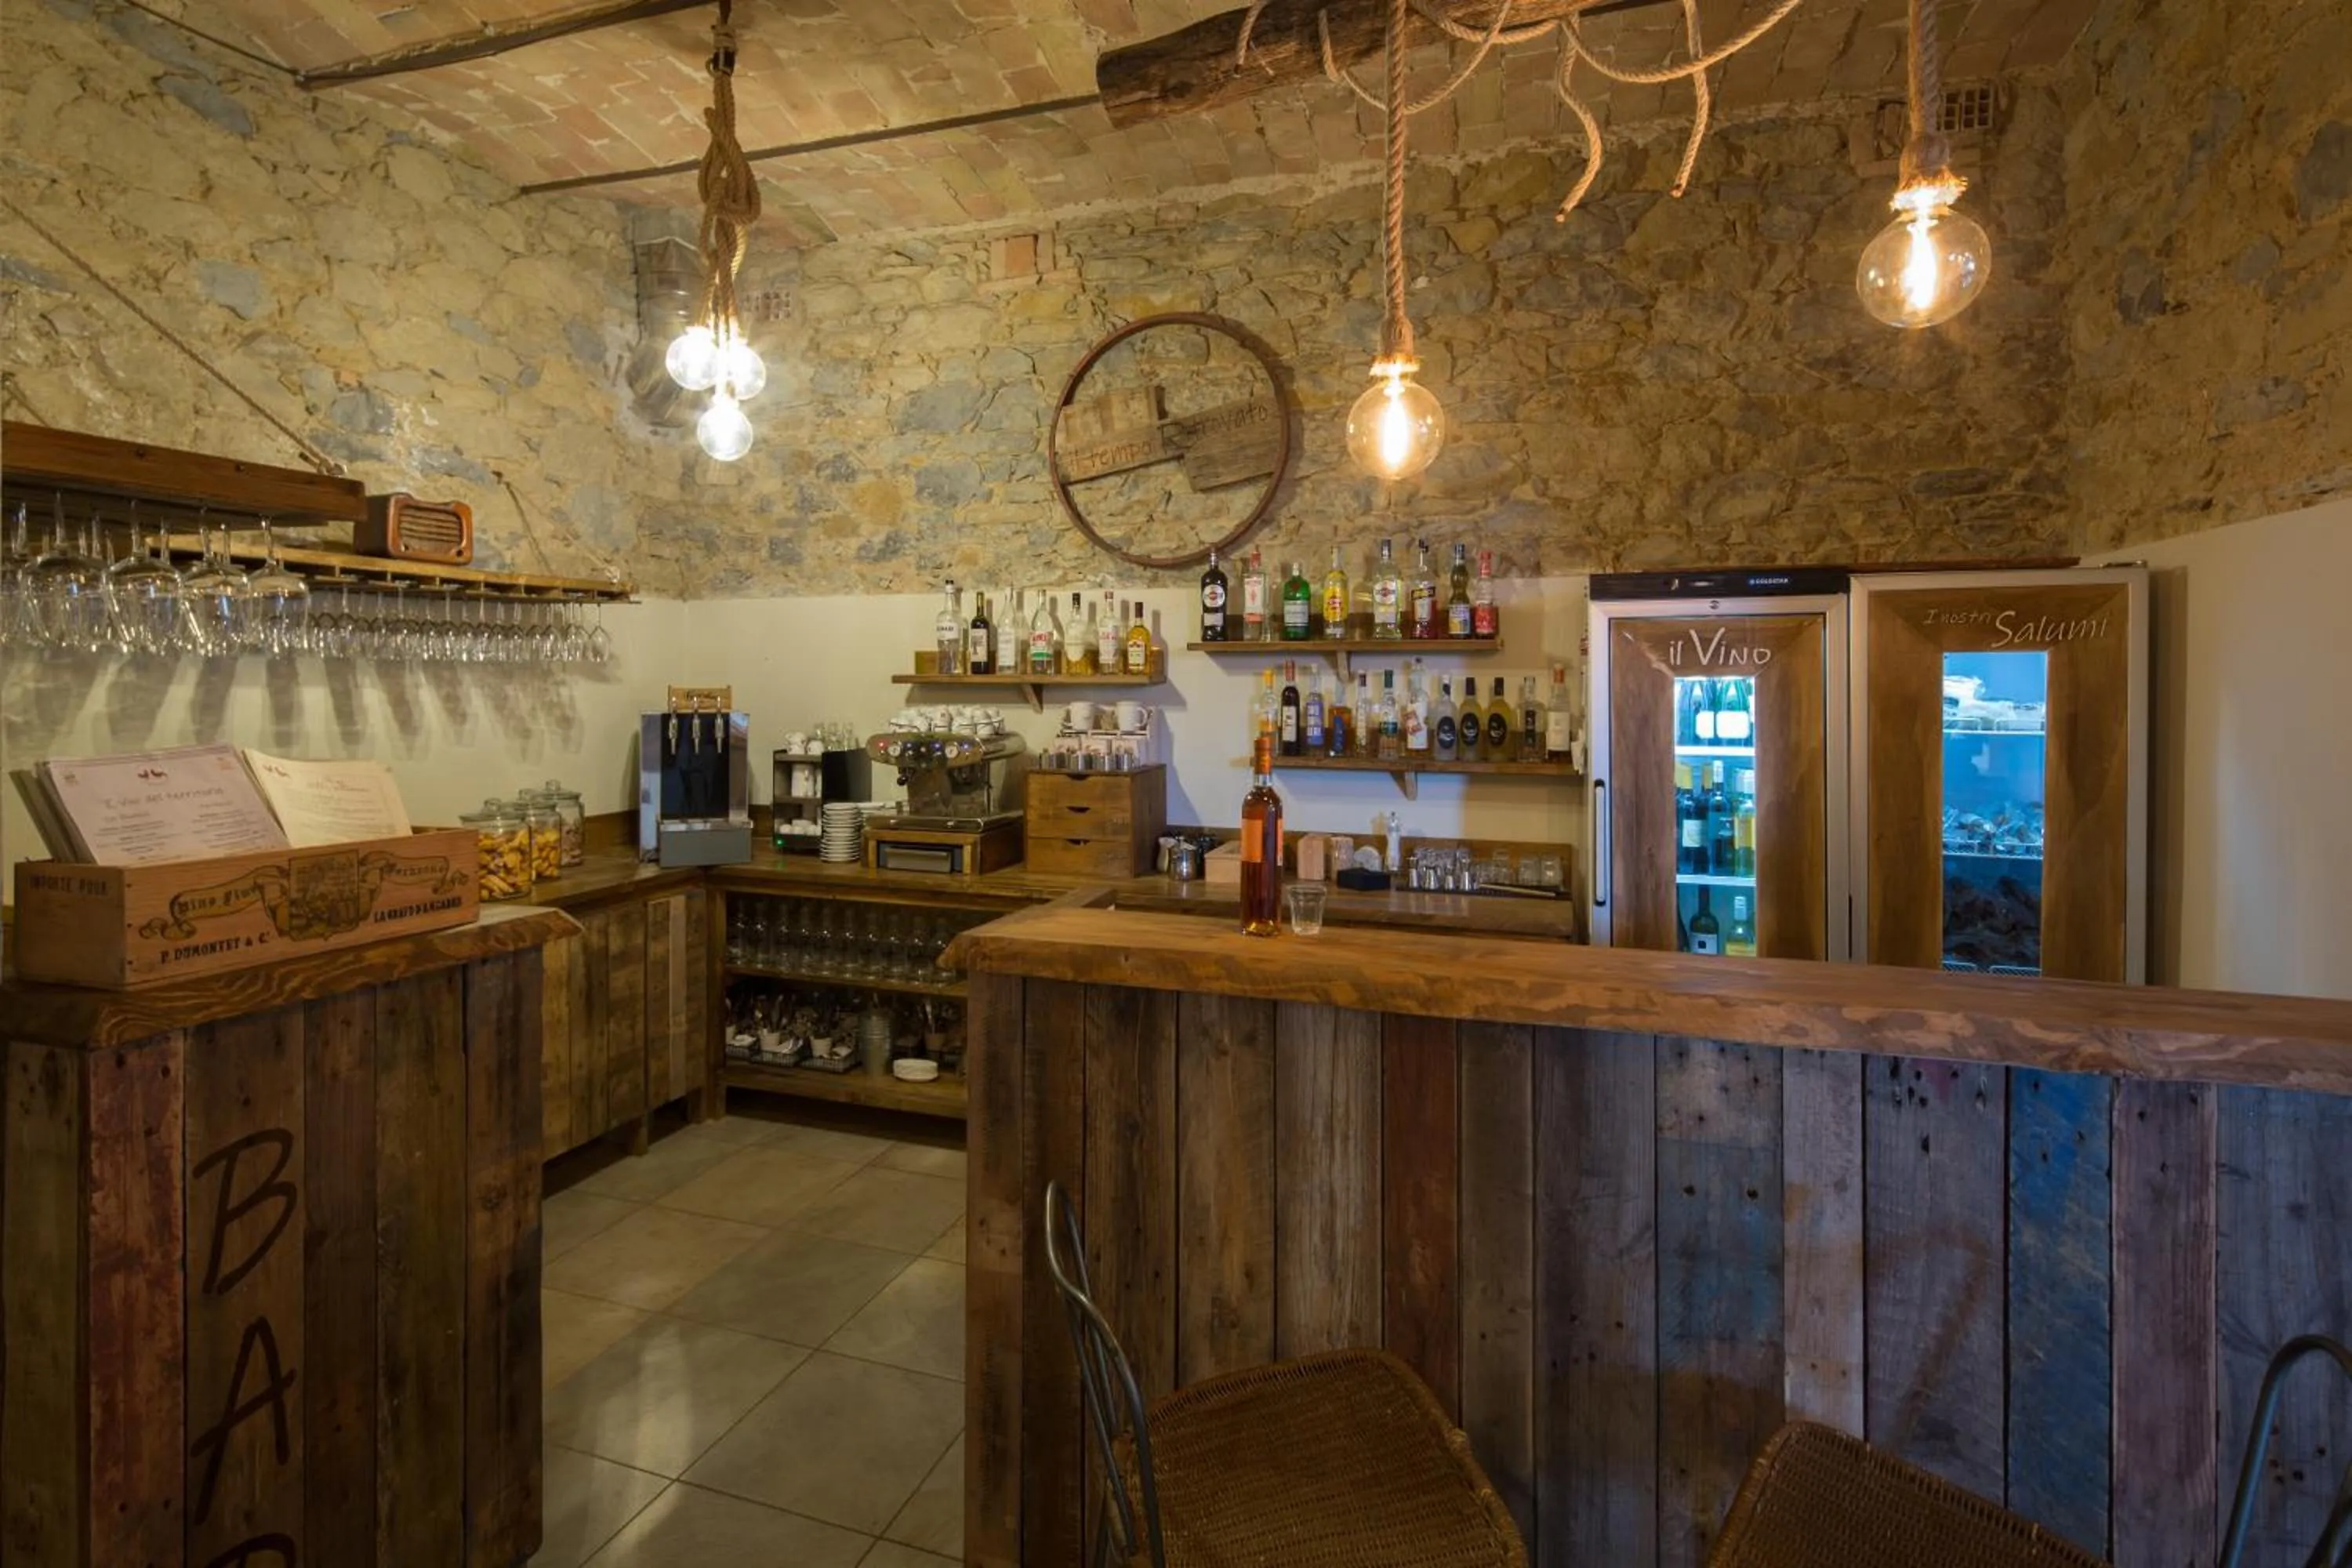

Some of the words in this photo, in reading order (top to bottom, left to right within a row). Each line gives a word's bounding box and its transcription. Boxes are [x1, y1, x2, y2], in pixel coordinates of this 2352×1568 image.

[1991, 611, 2107, 648] Salumi
[174, 936, 241, 961] DUMONTET
[191, 1127, 298, 1568] BA
